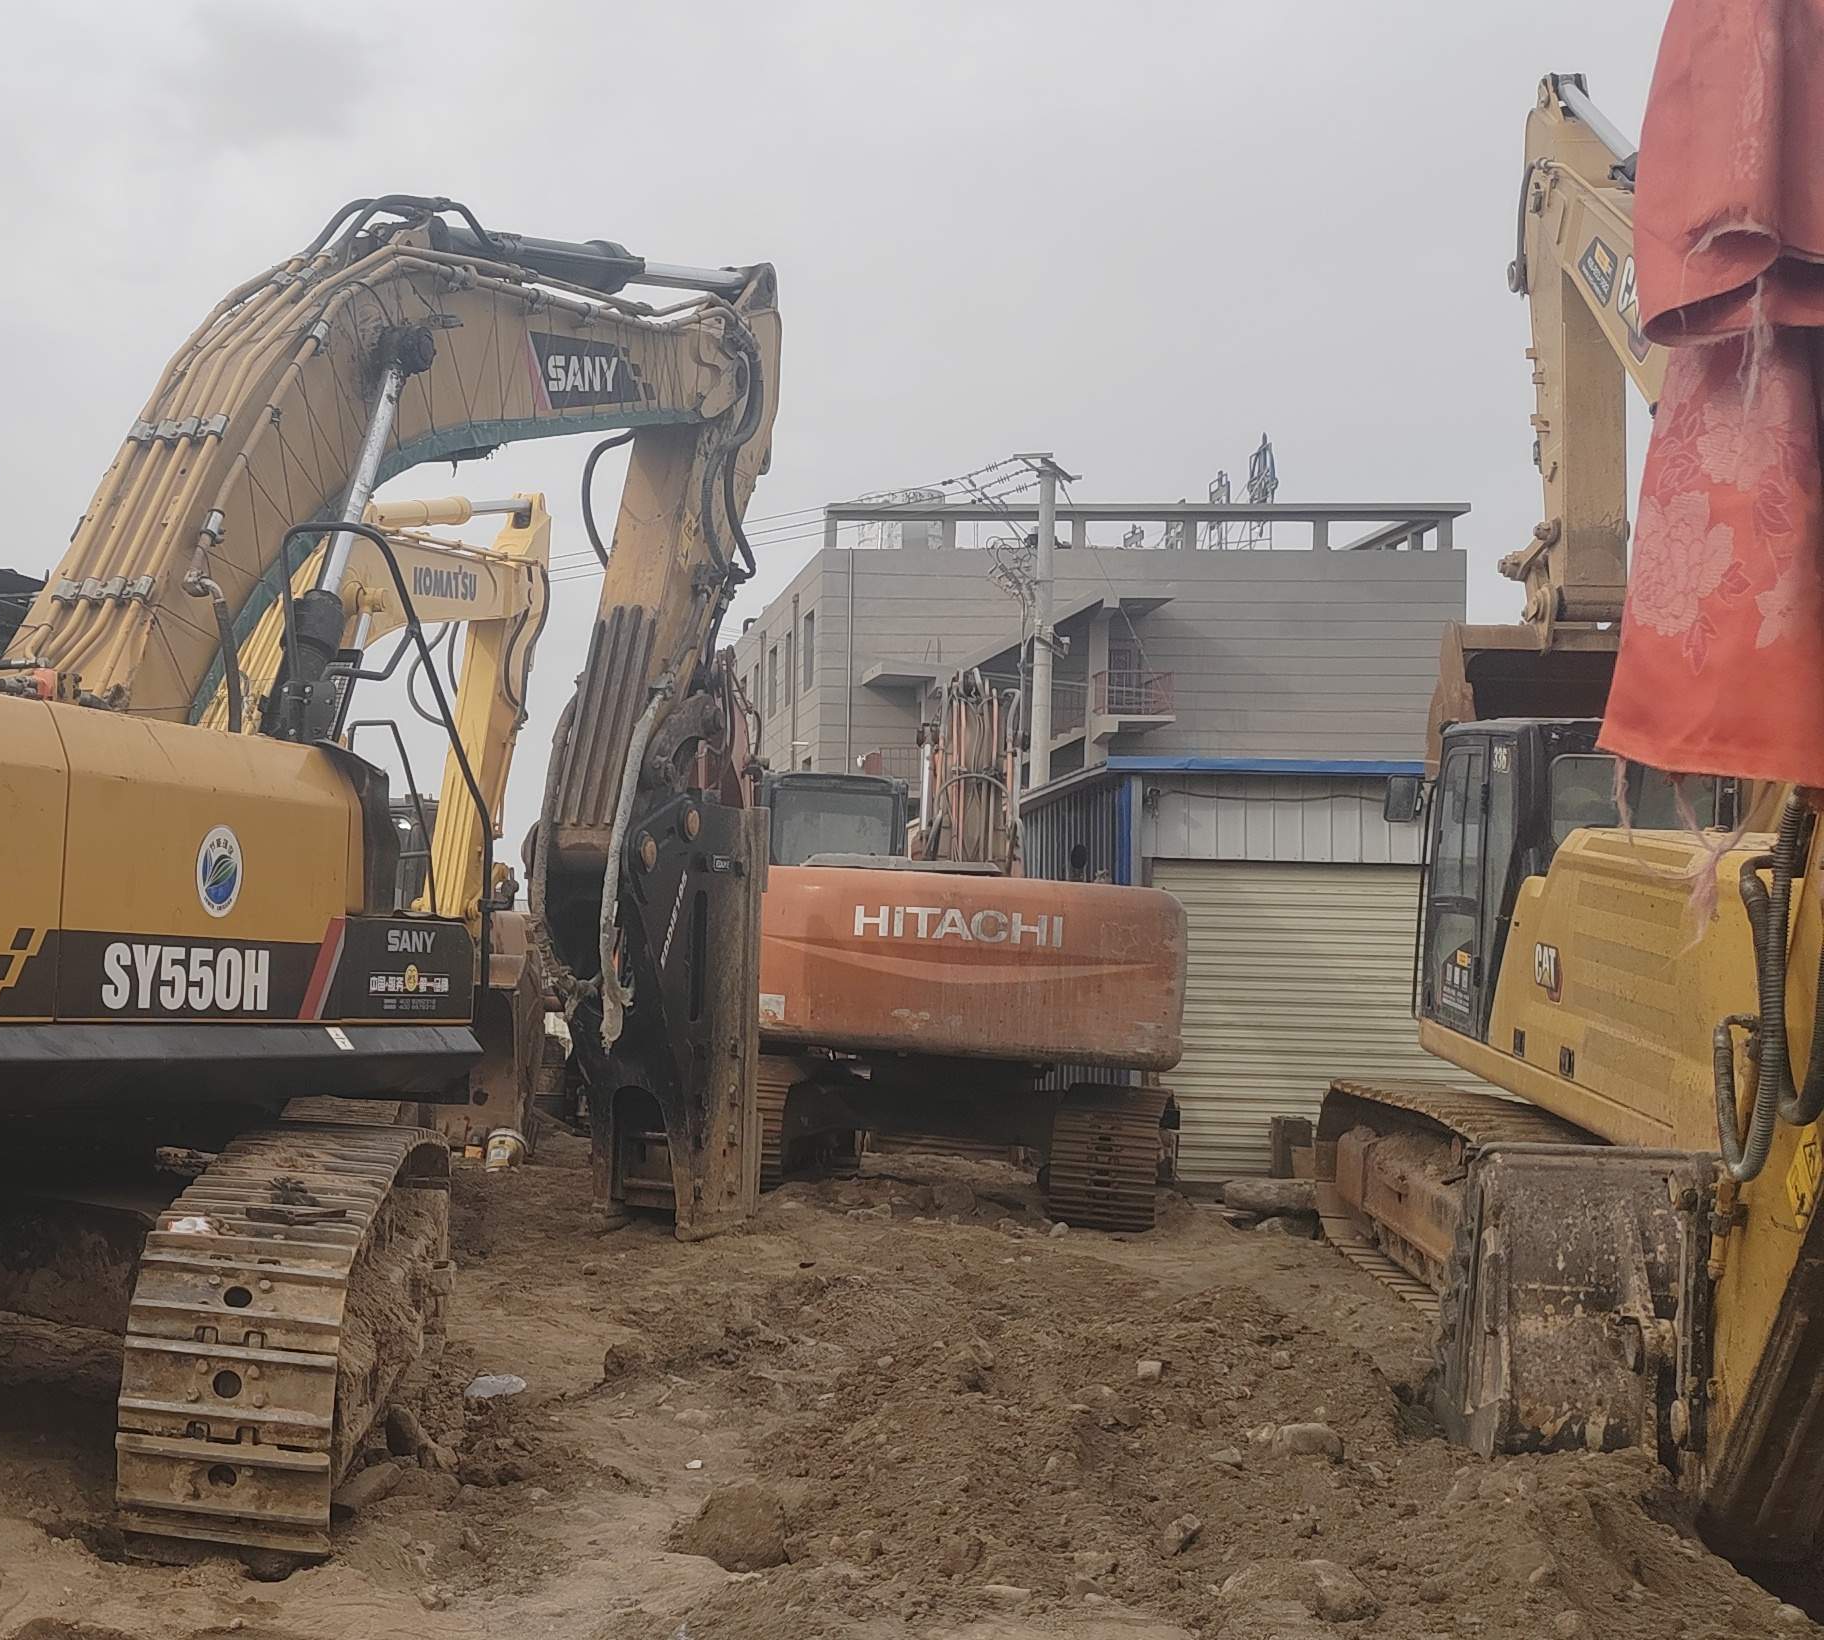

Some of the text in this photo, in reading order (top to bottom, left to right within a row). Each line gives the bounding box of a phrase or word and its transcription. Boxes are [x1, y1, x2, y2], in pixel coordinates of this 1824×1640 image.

[548, 355, 618, 392] SANY
[413, 564, 477, 601] KOMATSU
[387, 929, 436, 953] SANY
[853, 905, 1064, 947] HITACHI
[101, 942, 270, 1011] SY550H
[1535, 943, 1557, 988] CAT
